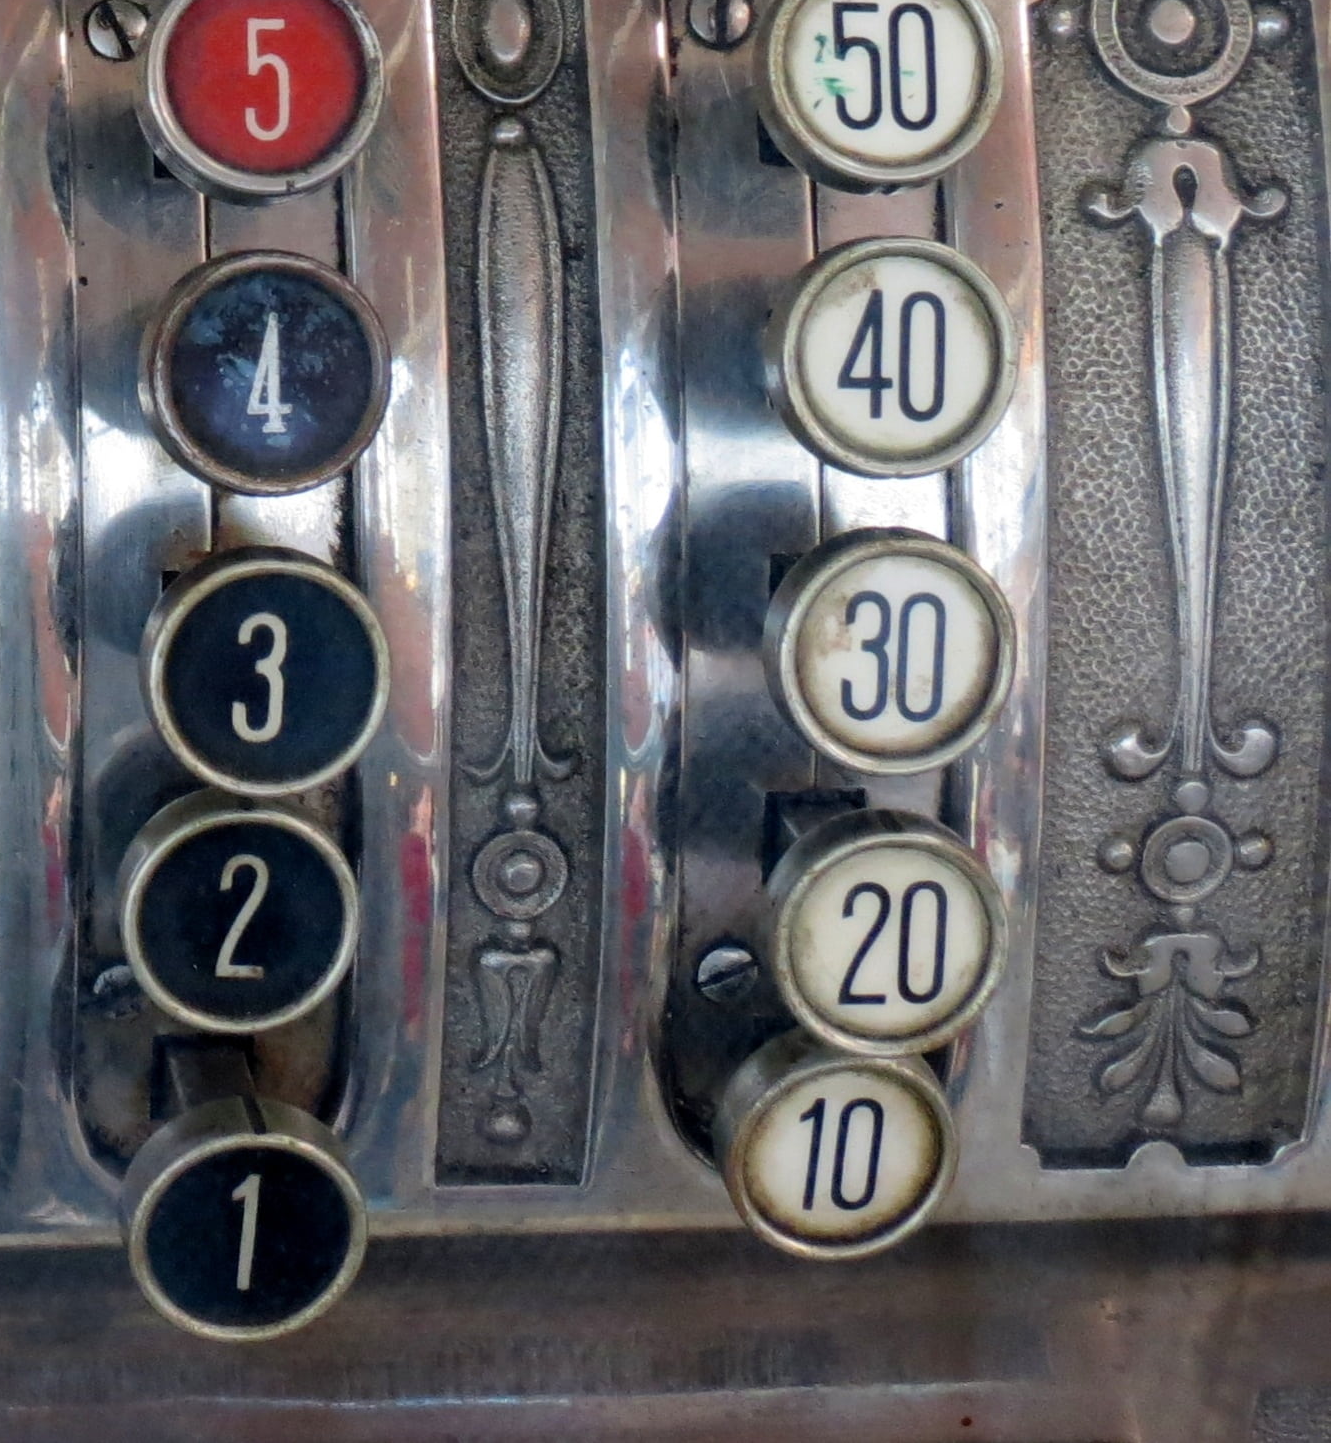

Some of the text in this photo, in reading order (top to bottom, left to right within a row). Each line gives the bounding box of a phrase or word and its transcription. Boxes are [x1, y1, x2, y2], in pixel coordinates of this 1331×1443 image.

[245, 18, 290, 141] 5
[833, 2, 937, 131] 50
[245, 310, 293, 434] 4
[838, 289, 945, 422] 40
[232, 612, 287, 742] 3
[836, 591, 946, 722] 30
[216, 854, 268, 977] 2
[838, 881, 947, 1005] 20
[800, 1098, 884, 1211] 10
[233, 1174, 260, 1290] 1
